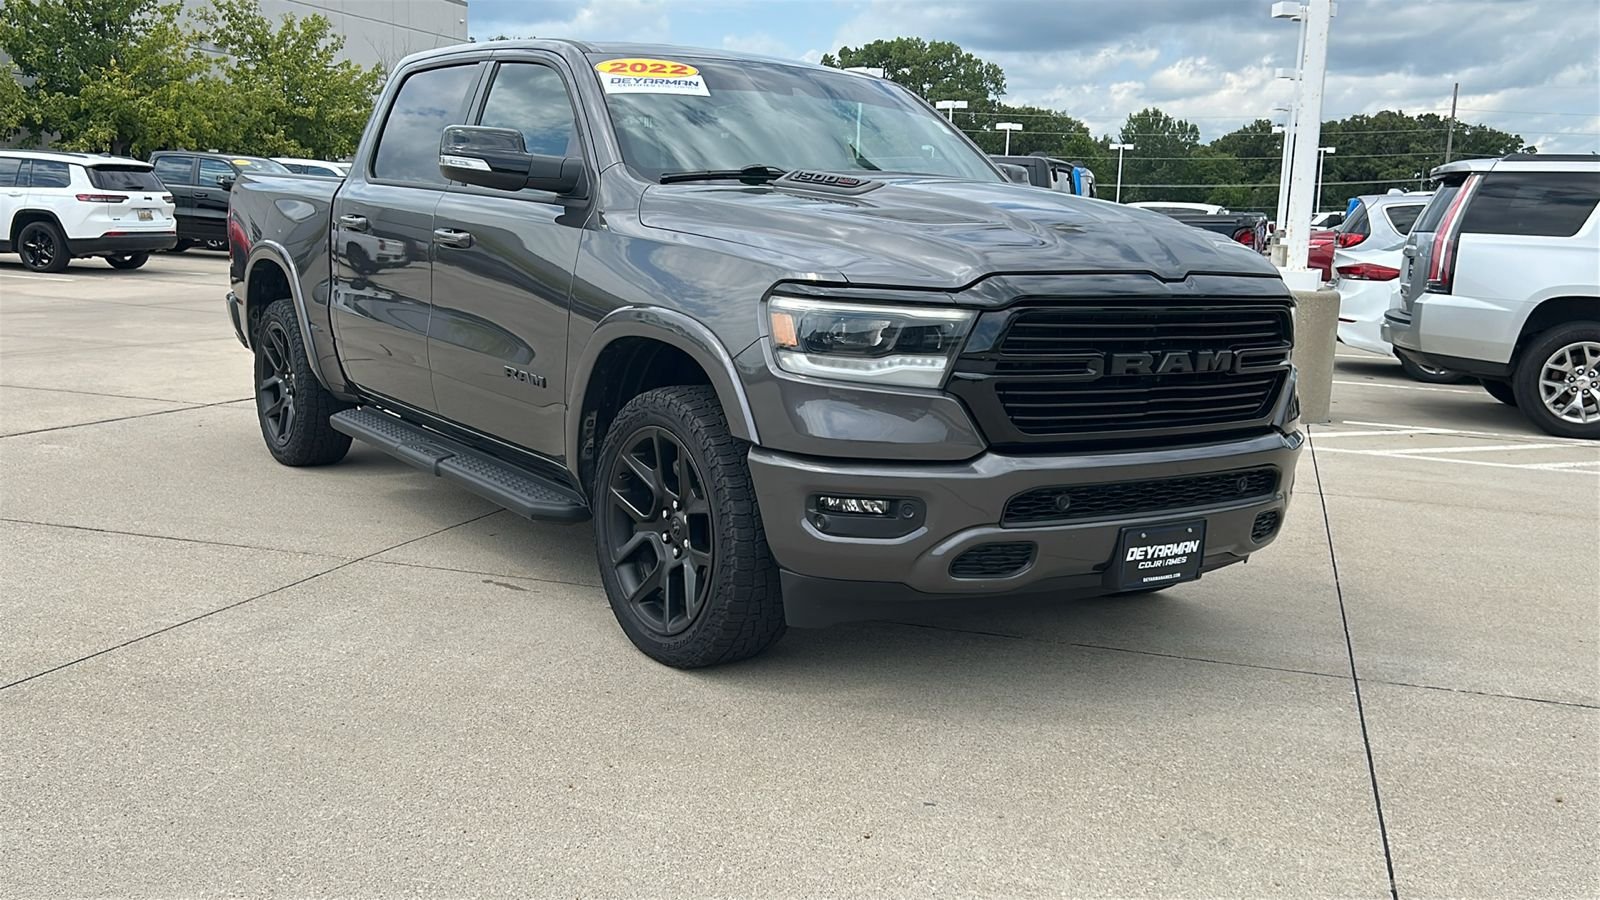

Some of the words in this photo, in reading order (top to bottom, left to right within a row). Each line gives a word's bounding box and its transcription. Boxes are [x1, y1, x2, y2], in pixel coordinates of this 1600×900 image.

[608, 62, 689, 75] 2022
[610, 77, 700, 87] DEYARMAN
[793, 170, 838, 184] 1500
[1110, 350, 1233, 376] RAM
[503, 365, 547, 389] RAM
[1126, 540, 1200, 561] DEYARMAN
